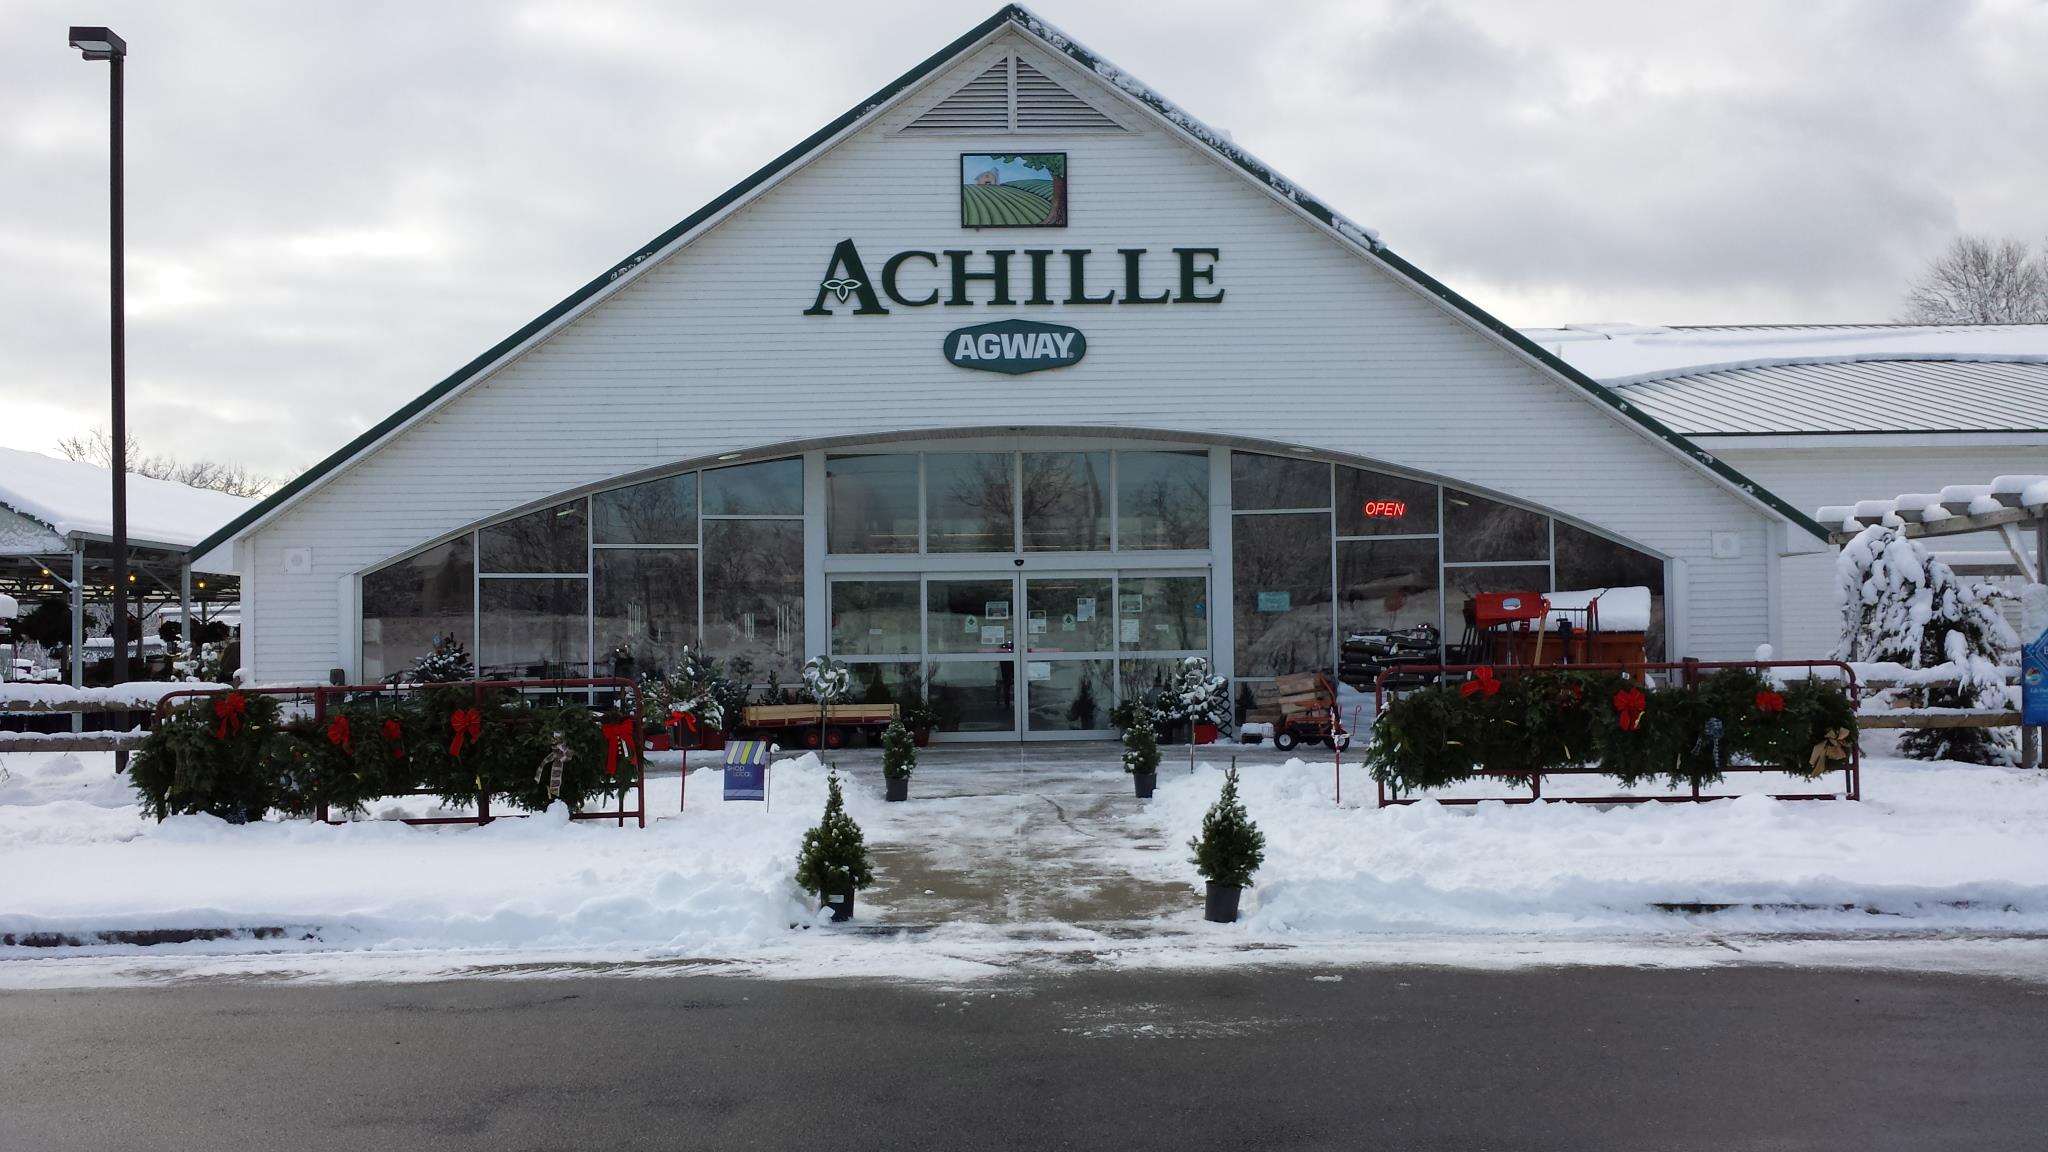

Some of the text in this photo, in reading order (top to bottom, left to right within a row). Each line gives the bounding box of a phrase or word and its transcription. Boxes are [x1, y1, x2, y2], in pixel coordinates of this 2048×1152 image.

[803, 238, 1225, 315] ACHILLE
[955, 333, 1075, 360] AGWAY
[1365, 501, 1405, 516] OPEN
